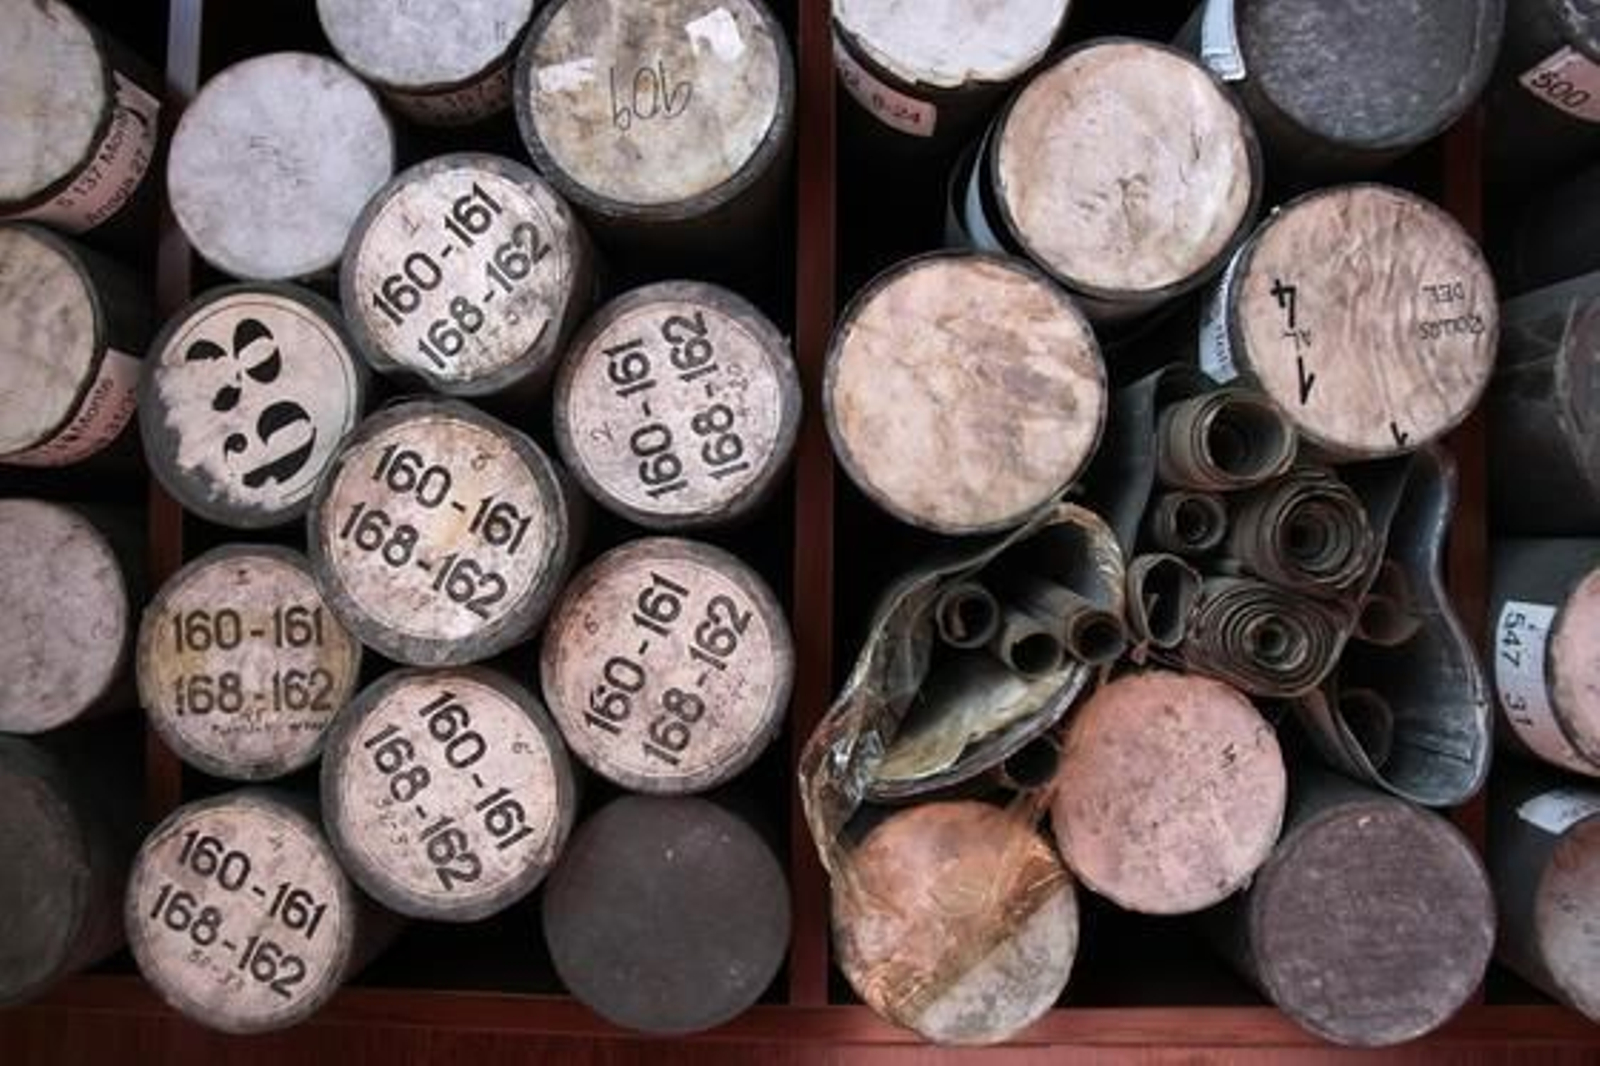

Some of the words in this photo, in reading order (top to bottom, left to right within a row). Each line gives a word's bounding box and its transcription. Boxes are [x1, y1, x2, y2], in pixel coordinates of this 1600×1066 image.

[1530, 67, 1592, 109] 500
[372, 182, 503, 325] 160-161
[418, 222, 552, 369] 168-162
[602, 338, 688, 499] 160-161
[661, 311, 750, 481] 168-162
[340, 501, 507, 621] 168-162
[371, 444, 532, 554] 160-161
[173, 606, 324, 654] 160-161
[173, 668, 335, 717] 168-162
[584, 571, 690, 736] 160-161
[643, 594, 753, 767] 168-162
[1500, 611, 1527, 669] 547
[363, 724, 483, 891] 168-162
[418, 690, 535, 850] 160-161
[150, 884, 307, 1001] 168-162
[176, 829, 328, 940] 160-161
